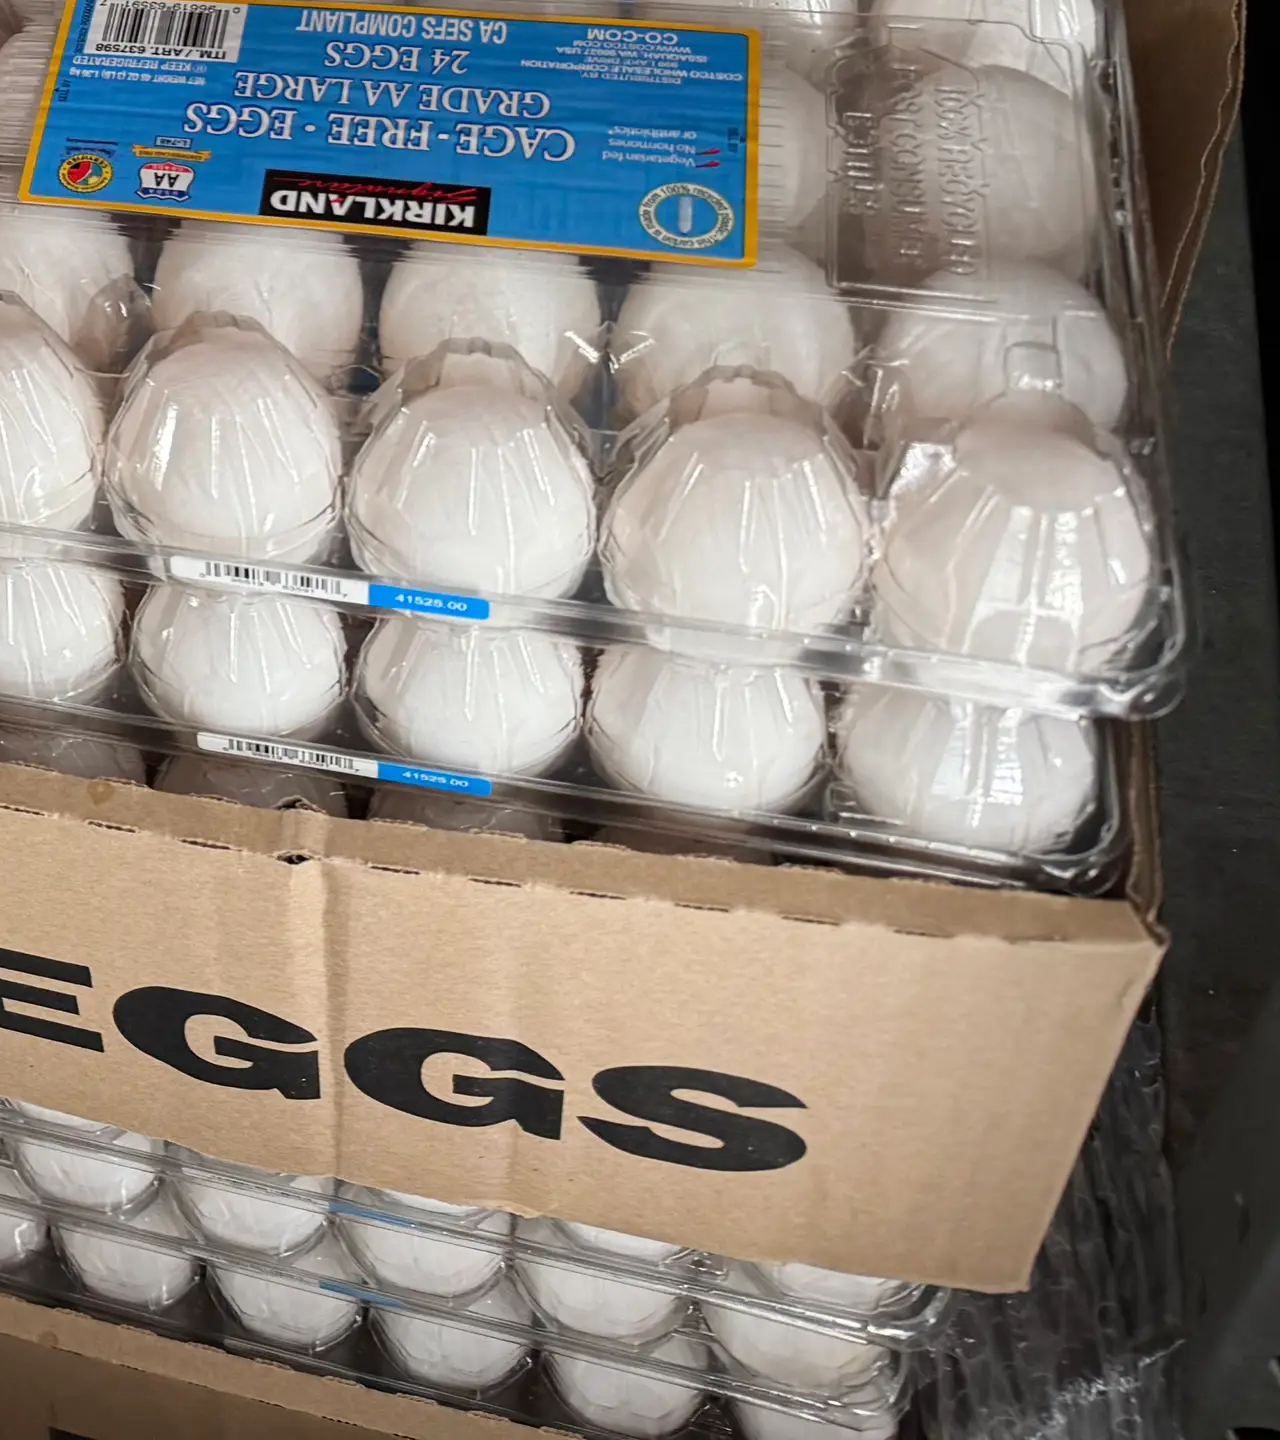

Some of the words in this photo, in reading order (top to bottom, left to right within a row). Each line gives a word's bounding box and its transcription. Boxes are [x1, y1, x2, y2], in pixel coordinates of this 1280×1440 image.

[296, 9, 417, 40] COMPLIANT
[422, 17, 474, 41] SEFS
[479, 19, 507, 43] CA
[587, 28, 678, 45] CO-COM
[95, 43, 146, 54] 637598
[150, 46, 184, 57] ART.
[196, 50, 226, 60] ITM.
[73, 56, 158, 69] REFRIGERATED
[324, 41, 421, 73] EGGS
[431, 48, 471, 74] 24
[161, 61, 191, 72] KEEP
[520, 60, 608, 72] CORPORATION
[609, 65, 687, 77] WHOLESALE
[690, 70, 742, 81] COSTCO
[234, 71, 353, 104] LARGE
[362, 80, 412, 108] AA
[418, 83, 551, 119] GRADE
[183, 102, 297, 140] EGGS
[327, 112, 575, 162] CAGE-FREE
[682, 132, 697, 140] or
[608, 138, 676, 153] hormones
[679, 144, 696, 154] No
[602, 150, 623, 161] fed
[626, 152, 696, 167] Vegetarian
[154, 172, 180, 188] AA
[269, 189, 476, 228] KIRKLAND
